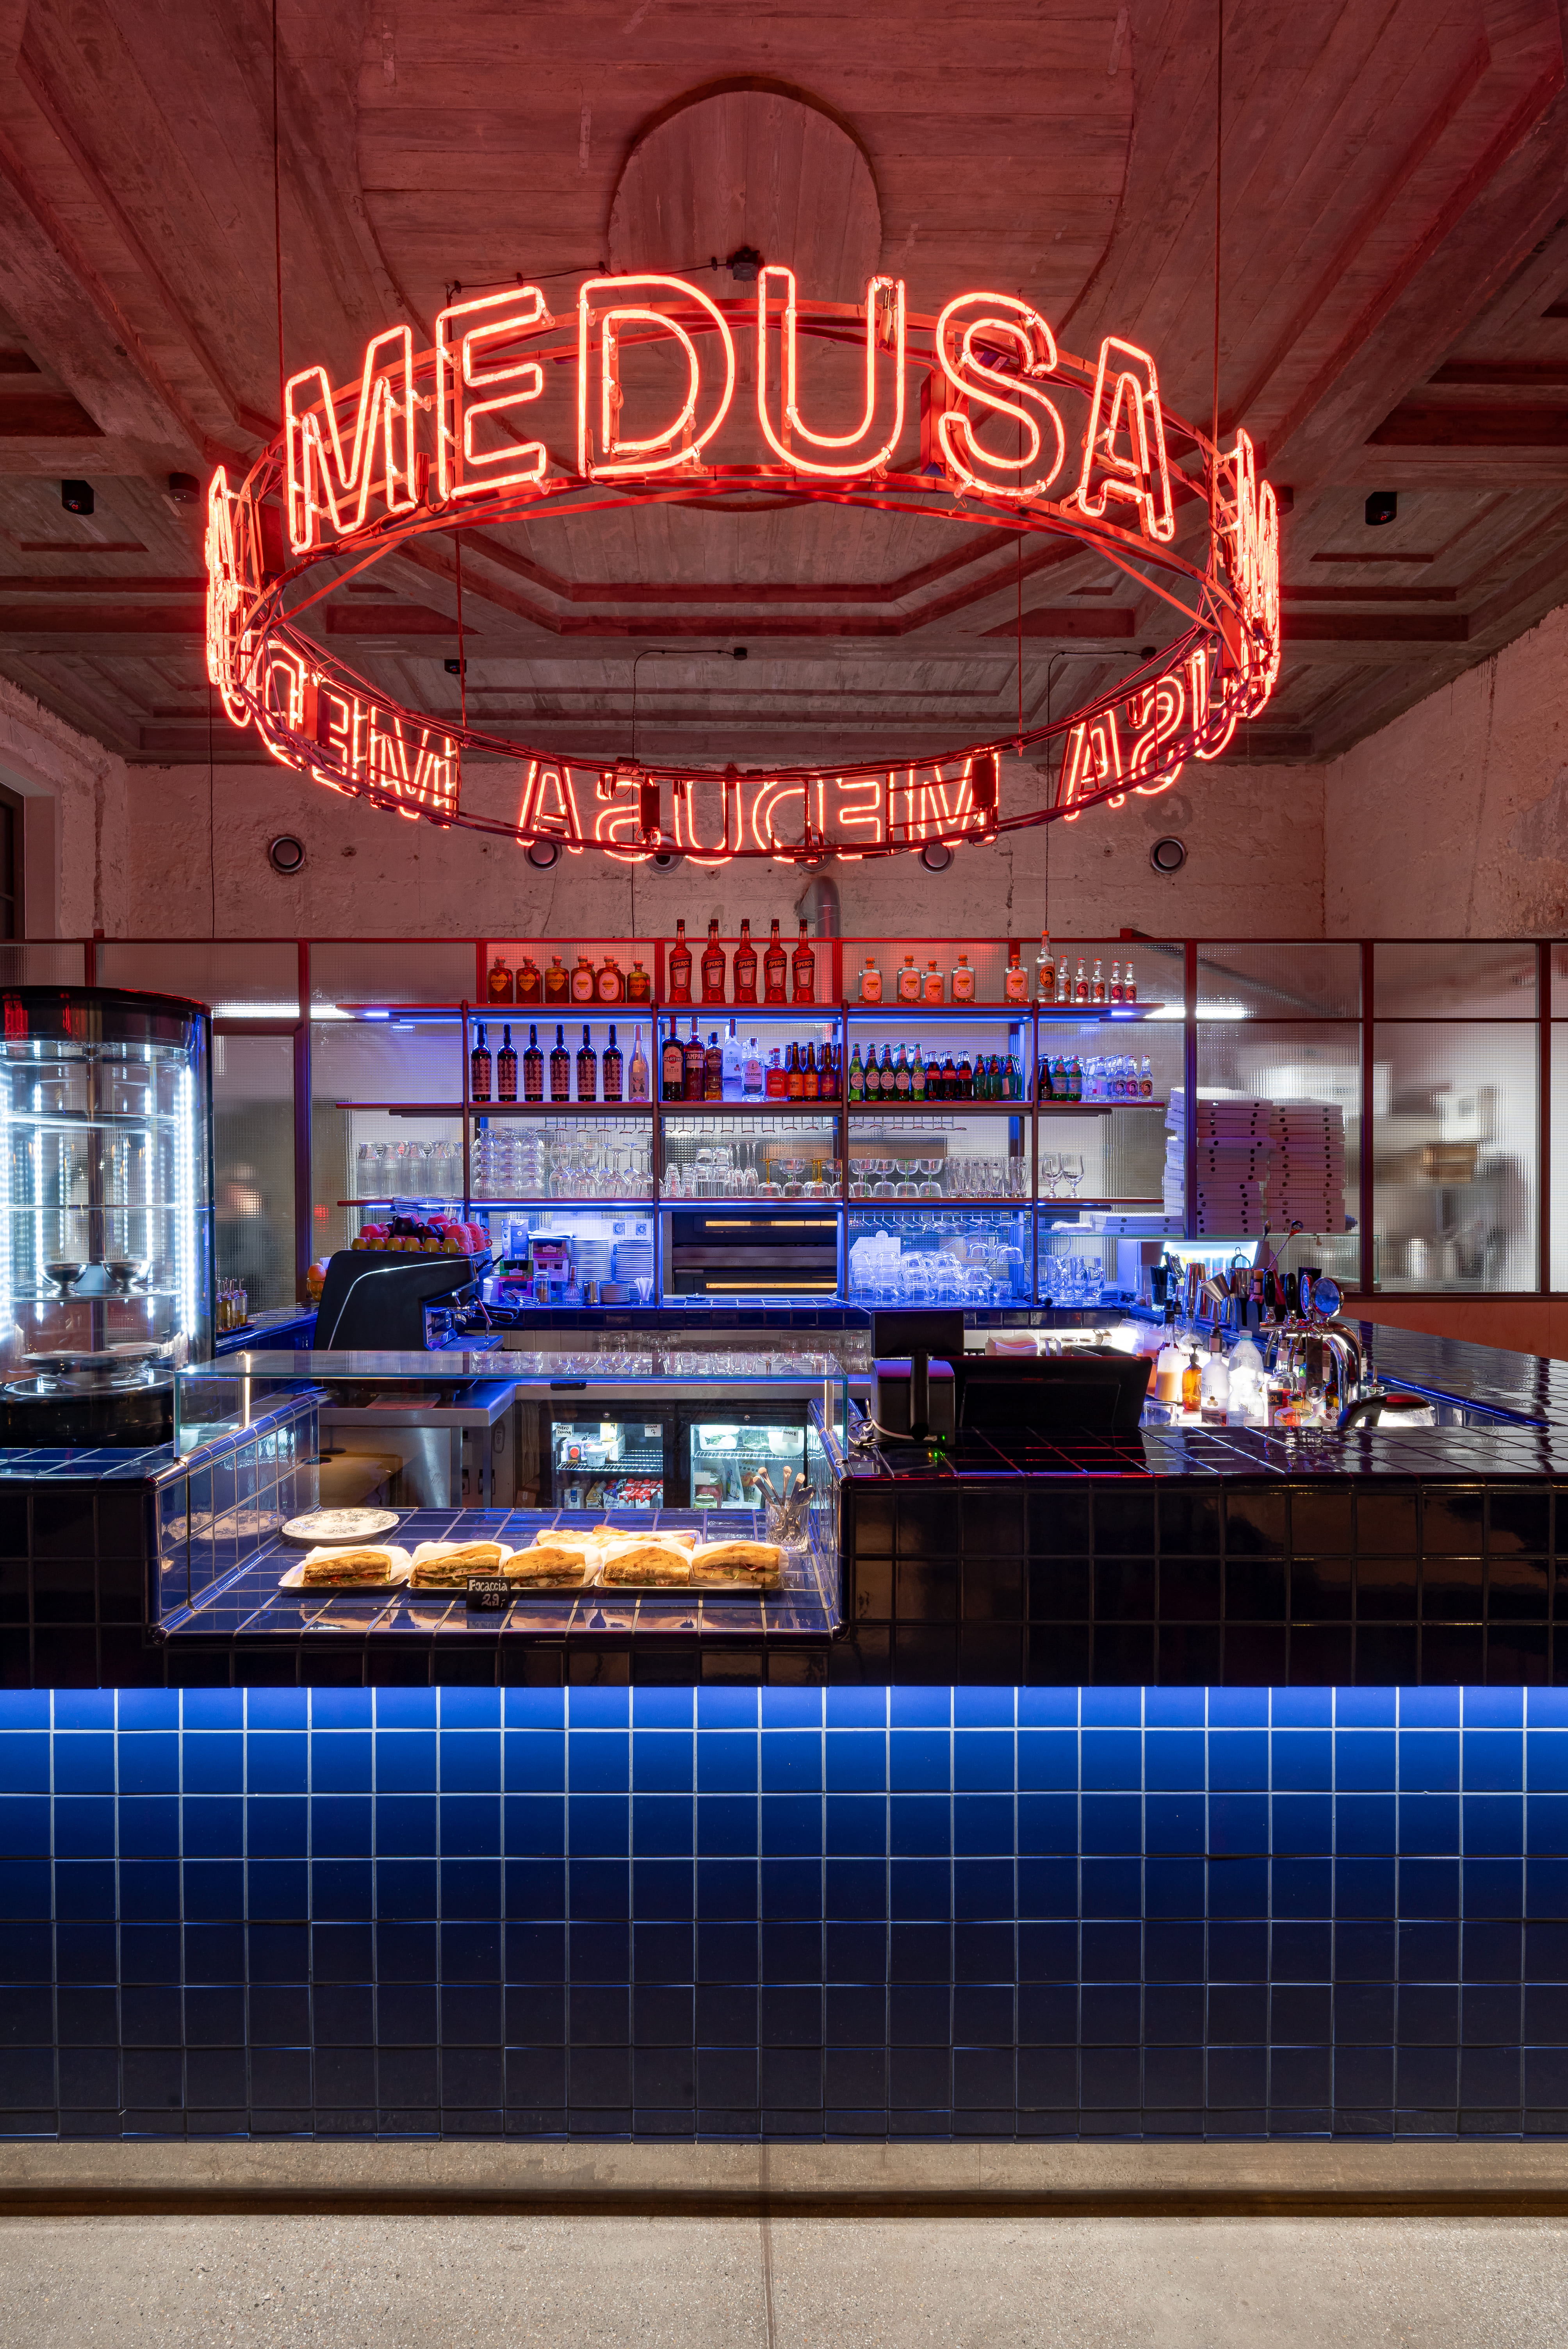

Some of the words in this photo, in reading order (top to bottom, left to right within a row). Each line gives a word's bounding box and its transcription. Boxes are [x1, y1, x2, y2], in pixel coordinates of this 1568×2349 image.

[283, 266, 1176, 556] MEDUSA
[706, 960, 723, 969] APEROL
[738, 960, 756, 968] APEROL
[768, 960, 786, 968] APEROL
[796, 961, 813, 969] APEROL
[1201, 1383, 1212, 1394] TOYA
[469, 1579, 508, 1592] Focaccia
